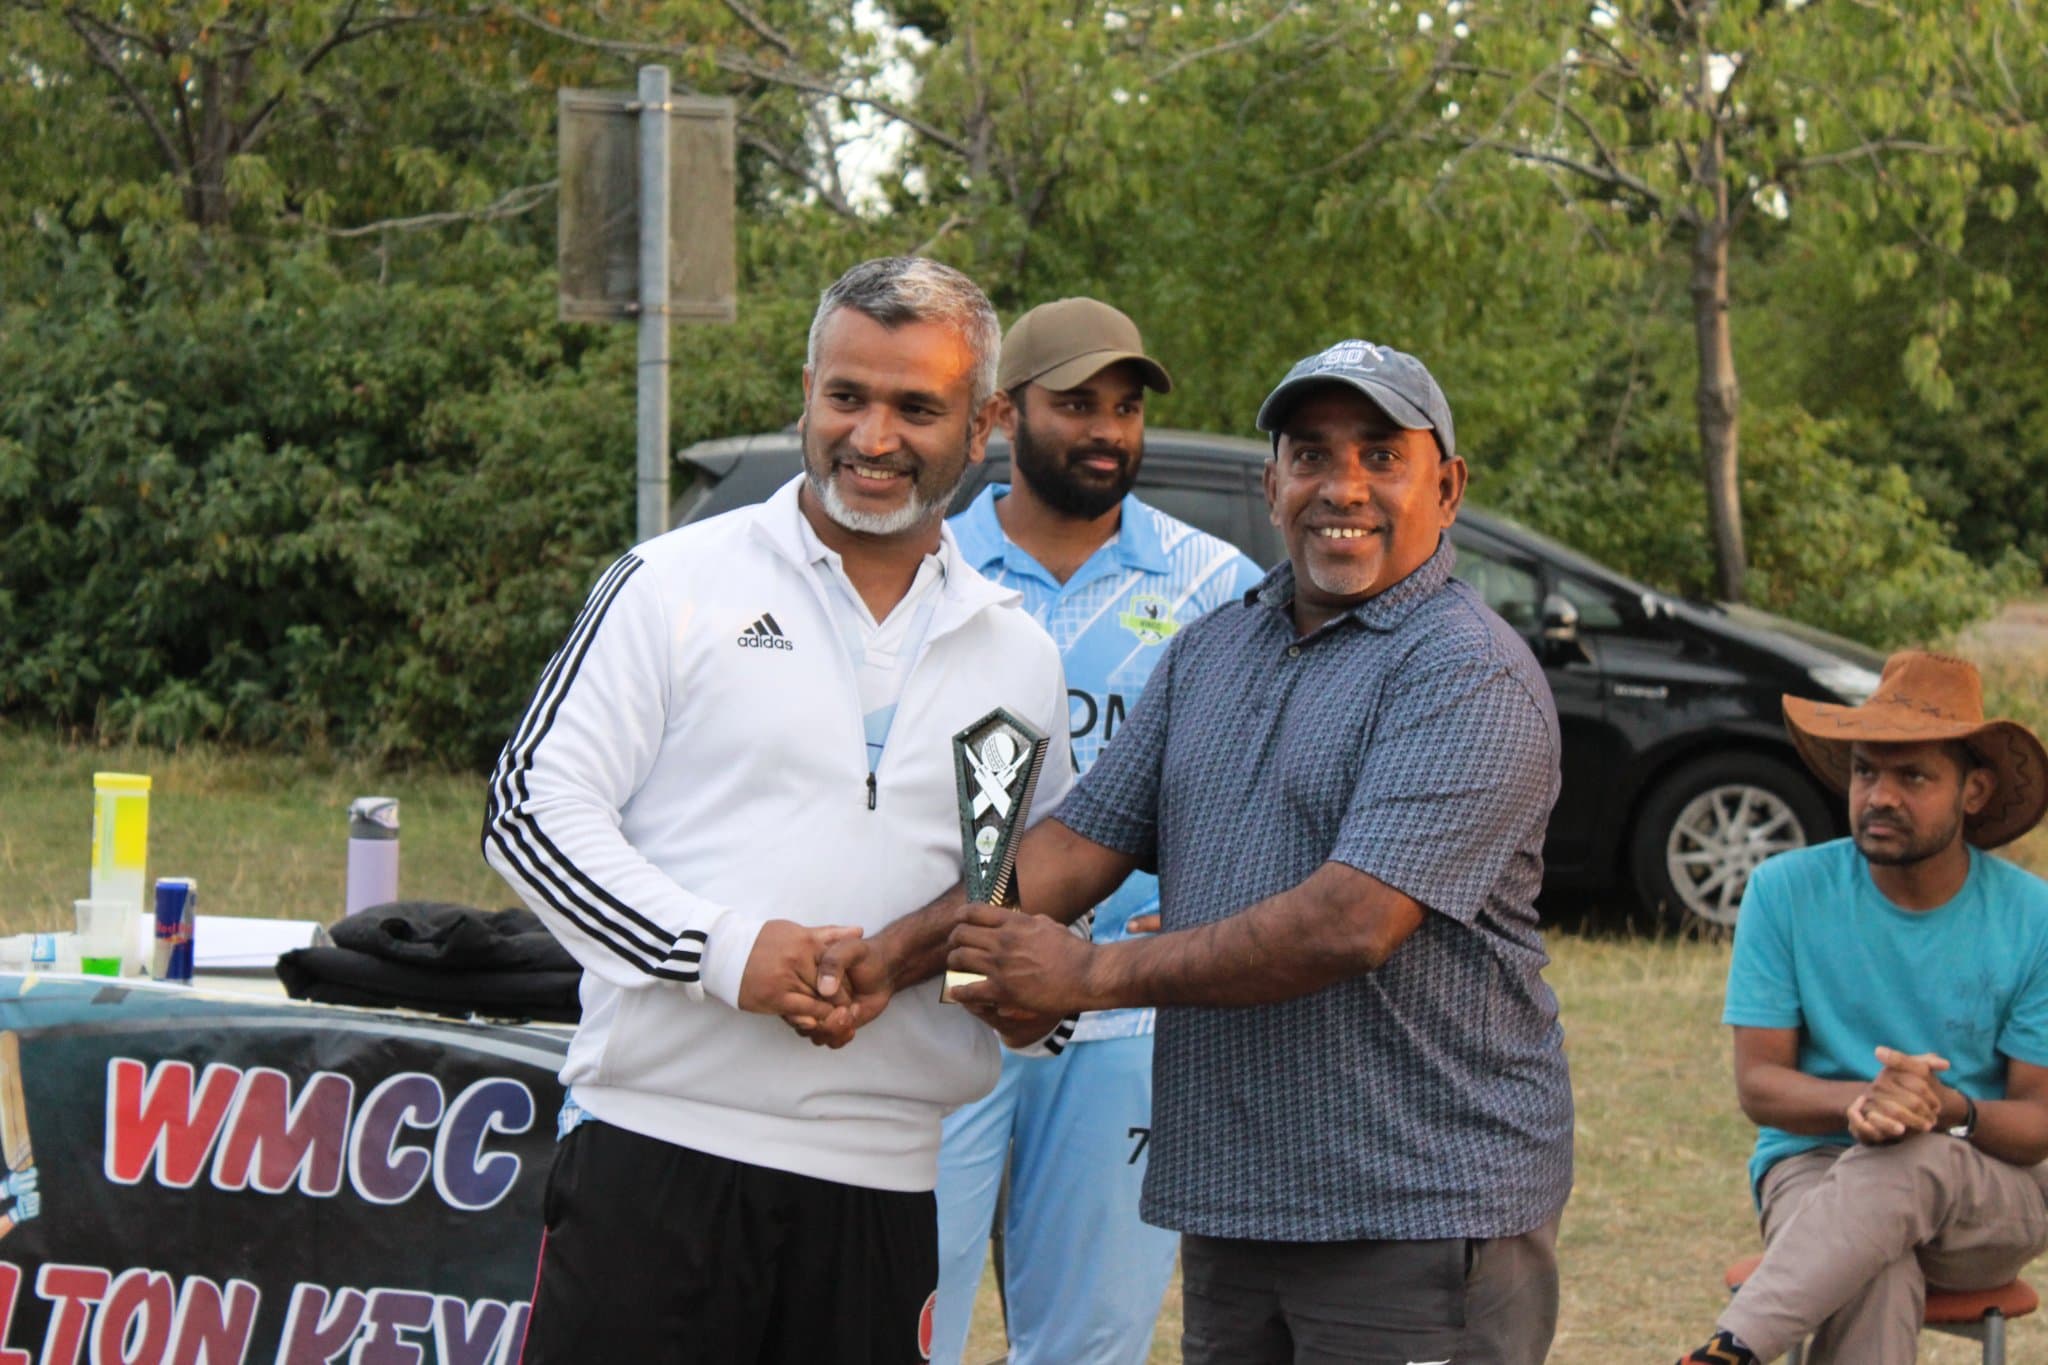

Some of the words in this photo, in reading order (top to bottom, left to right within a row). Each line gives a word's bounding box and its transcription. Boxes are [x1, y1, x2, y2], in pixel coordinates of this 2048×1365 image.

[737, 634, 793, 651] adidas
[105, 1056, 536, 1211] WMCC
[276, 1281, 534, 1365] KEY
